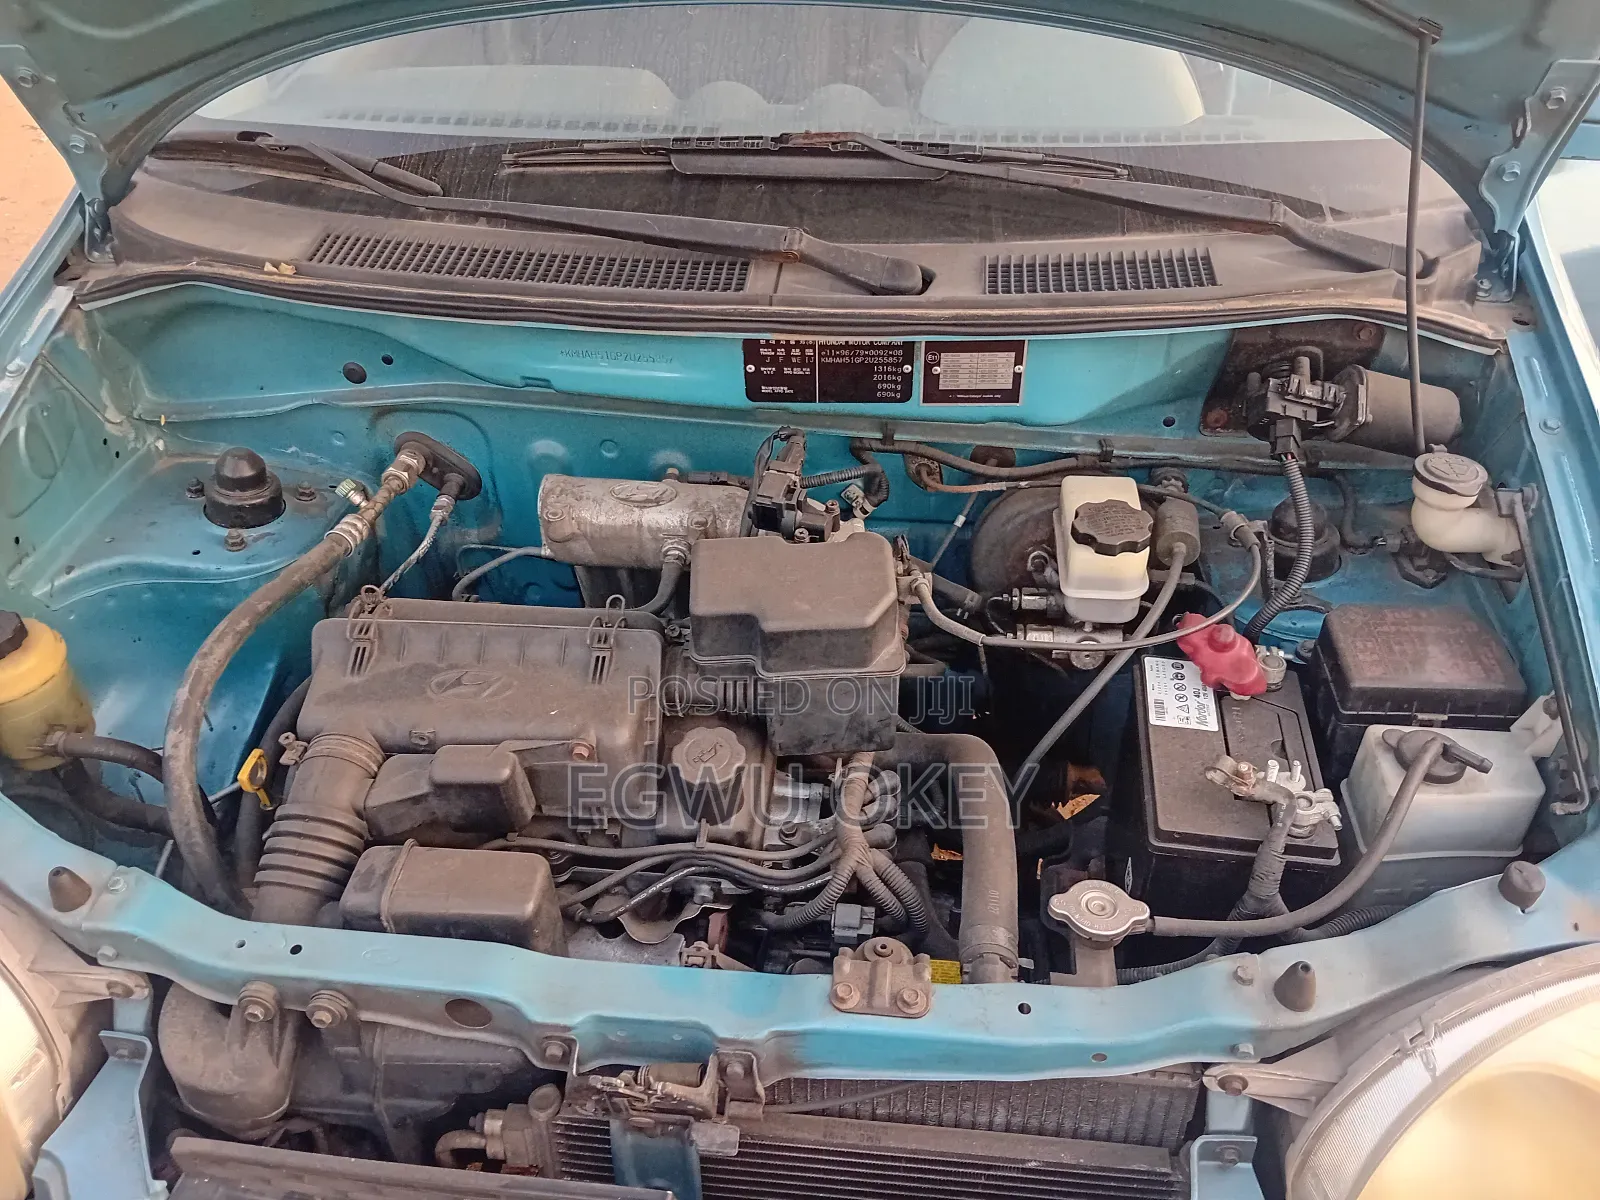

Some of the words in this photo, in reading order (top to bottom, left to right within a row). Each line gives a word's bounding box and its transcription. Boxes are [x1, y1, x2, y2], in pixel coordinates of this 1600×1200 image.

[872, 374, 902, 382] 2016kg
[877, 383, 902, 391] 690kg
[876, 391, 901, 399] 690kg
